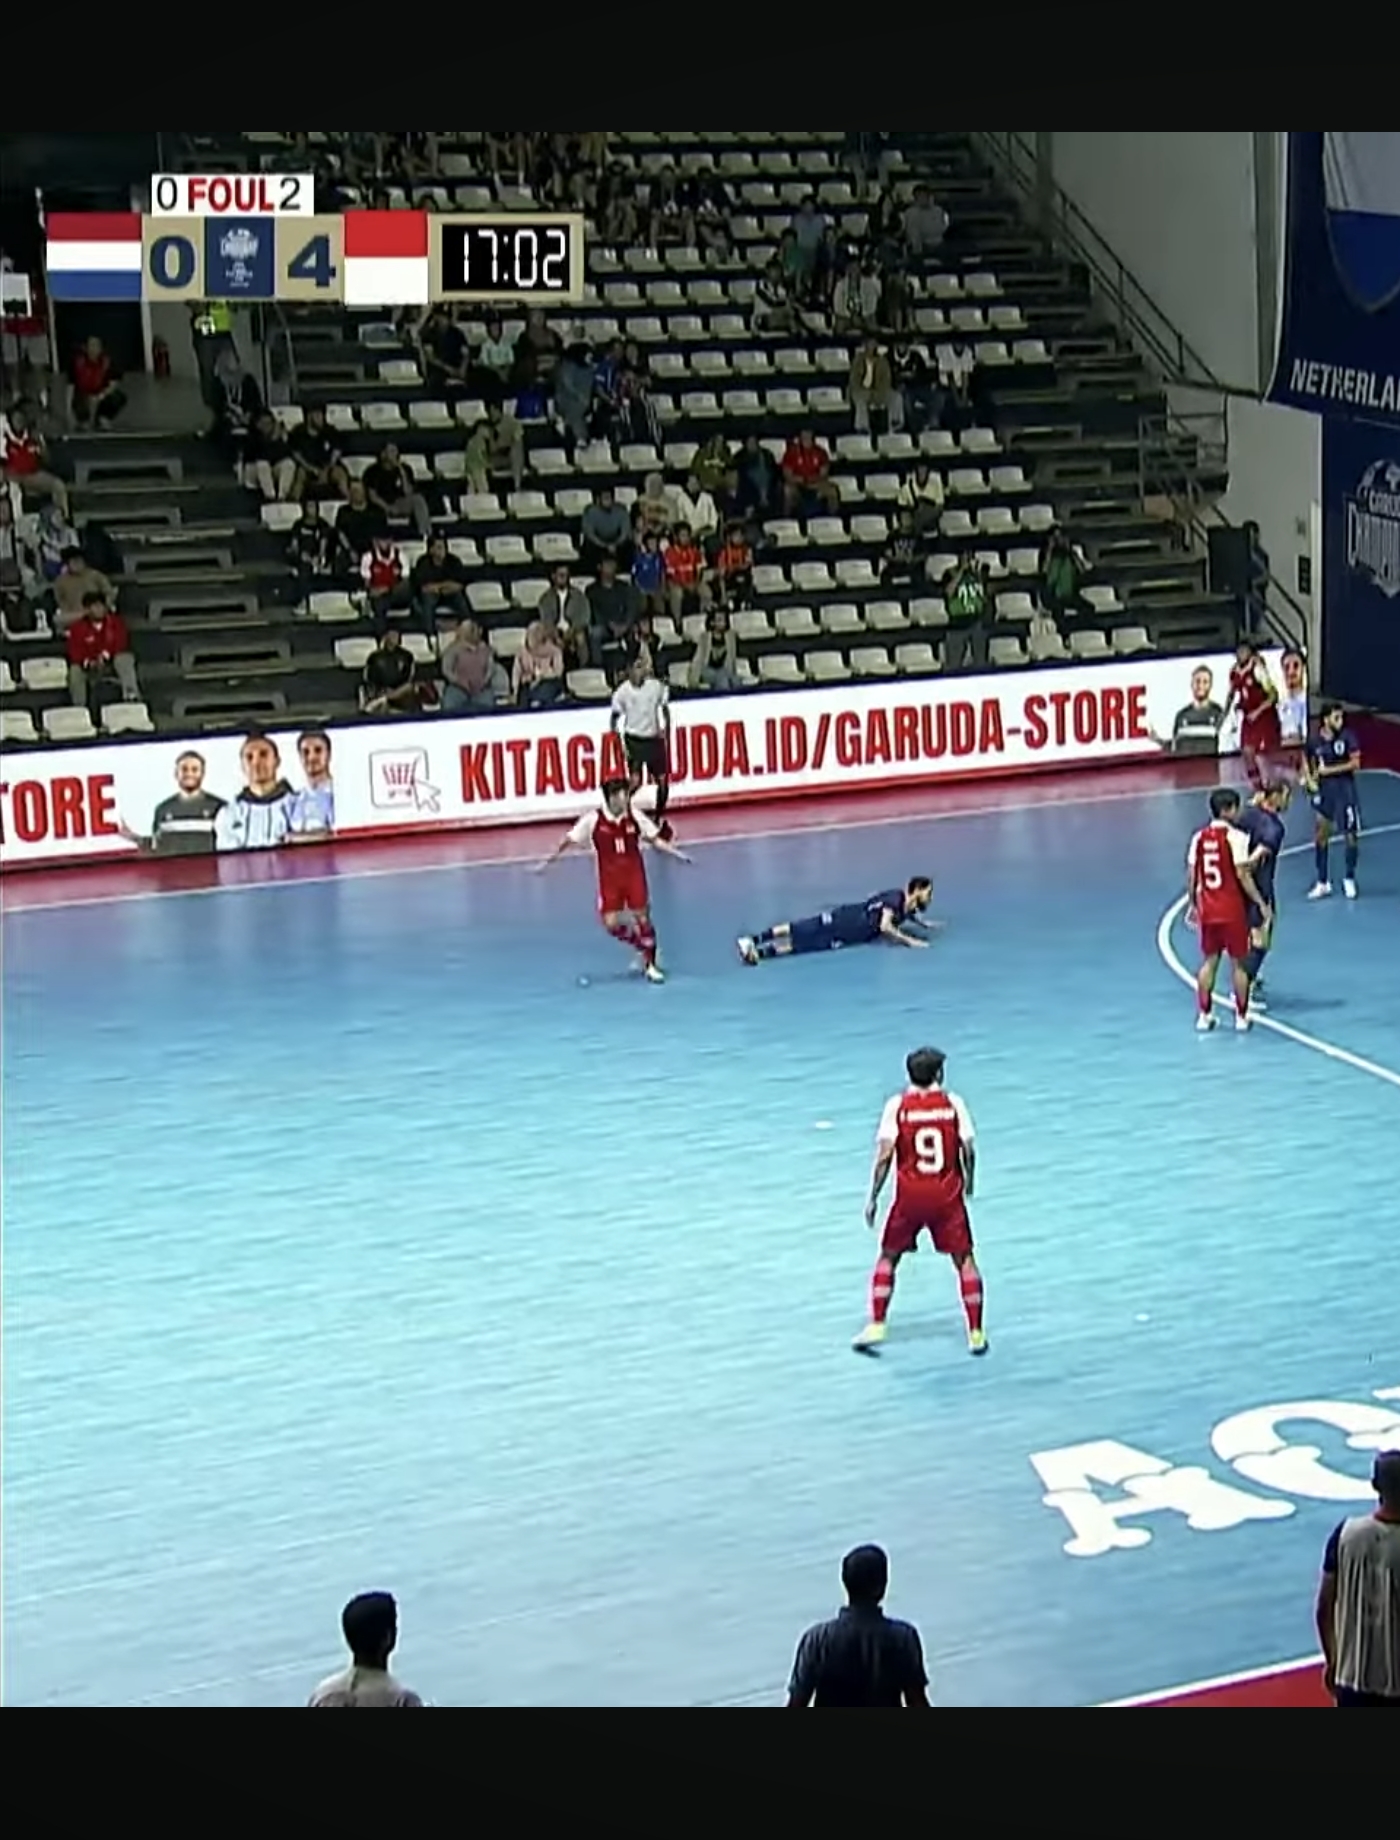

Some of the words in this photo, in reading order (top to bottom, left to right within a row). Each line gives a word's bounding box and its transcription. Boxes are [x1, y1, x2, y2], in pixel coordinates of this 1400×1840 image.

[459, 684, 1149, 803] KITAGAUDA.ID/GARUDA-STORE
[1203, 853, 1222, 889] 5
[914, 1126, 945, 1175] 9
